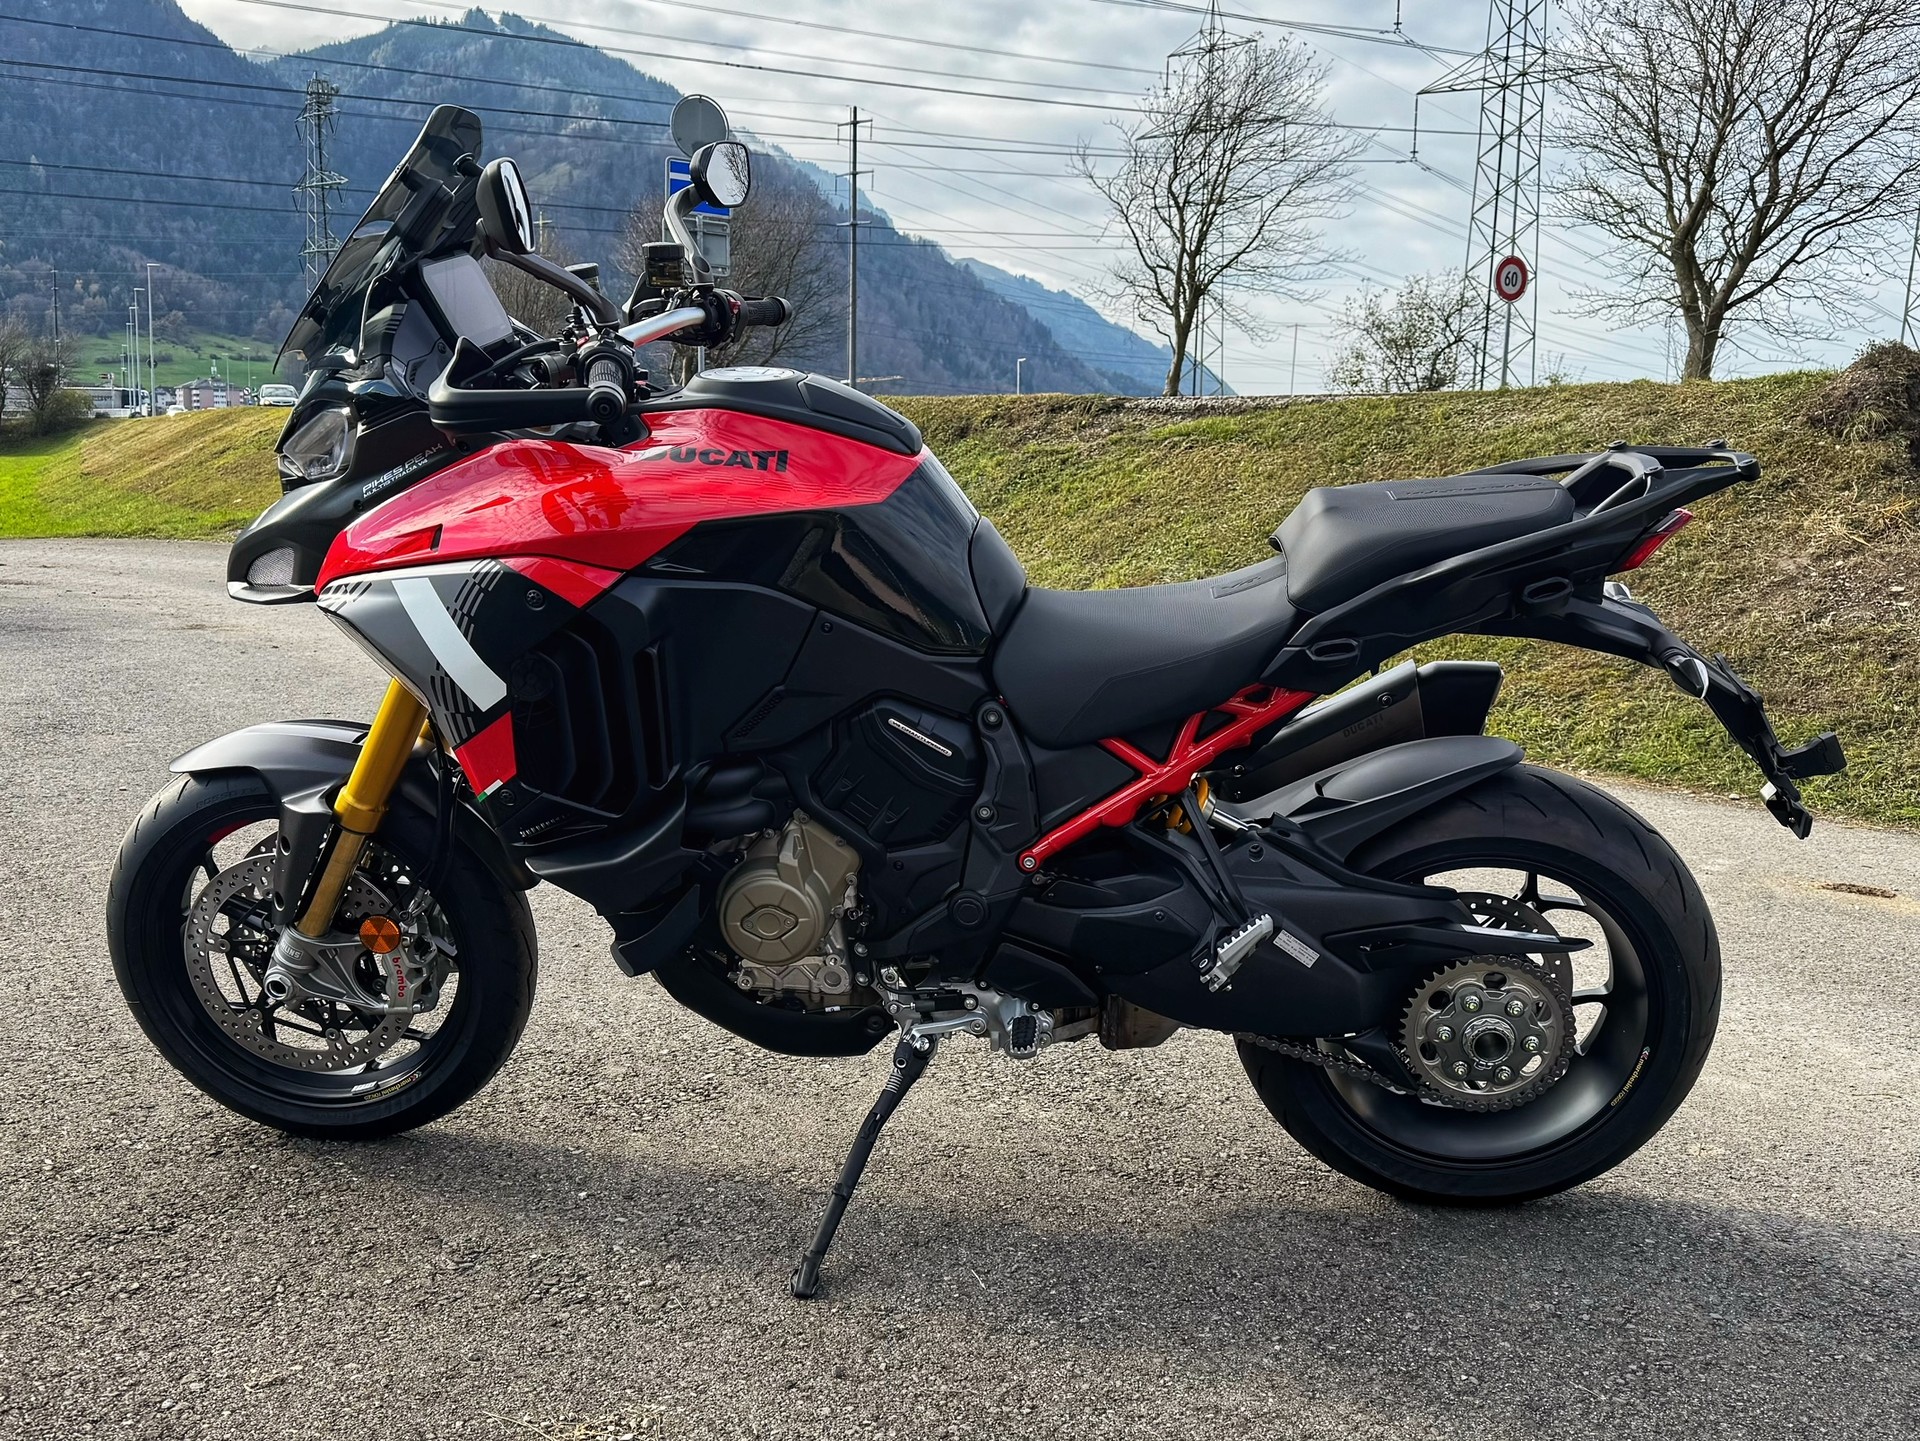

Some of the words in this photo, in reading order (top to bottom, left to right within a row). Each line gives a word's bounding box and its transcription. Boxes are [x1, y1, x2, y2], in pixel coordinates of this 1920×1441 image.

[1504, 270, 1518, 287] 60
[362, 464, 403, 493] PIKES
[405, 443, 443, 469] PEAK
[363, 465, 417, 498] MULTISTRADA
[1343, 713, 1384, 738] DUCATI
[392, 956, 407, 998] brembo
[382, 1076, 412, 1097] marchesini
[1623, 1058, 1645, 1092] marchesini
